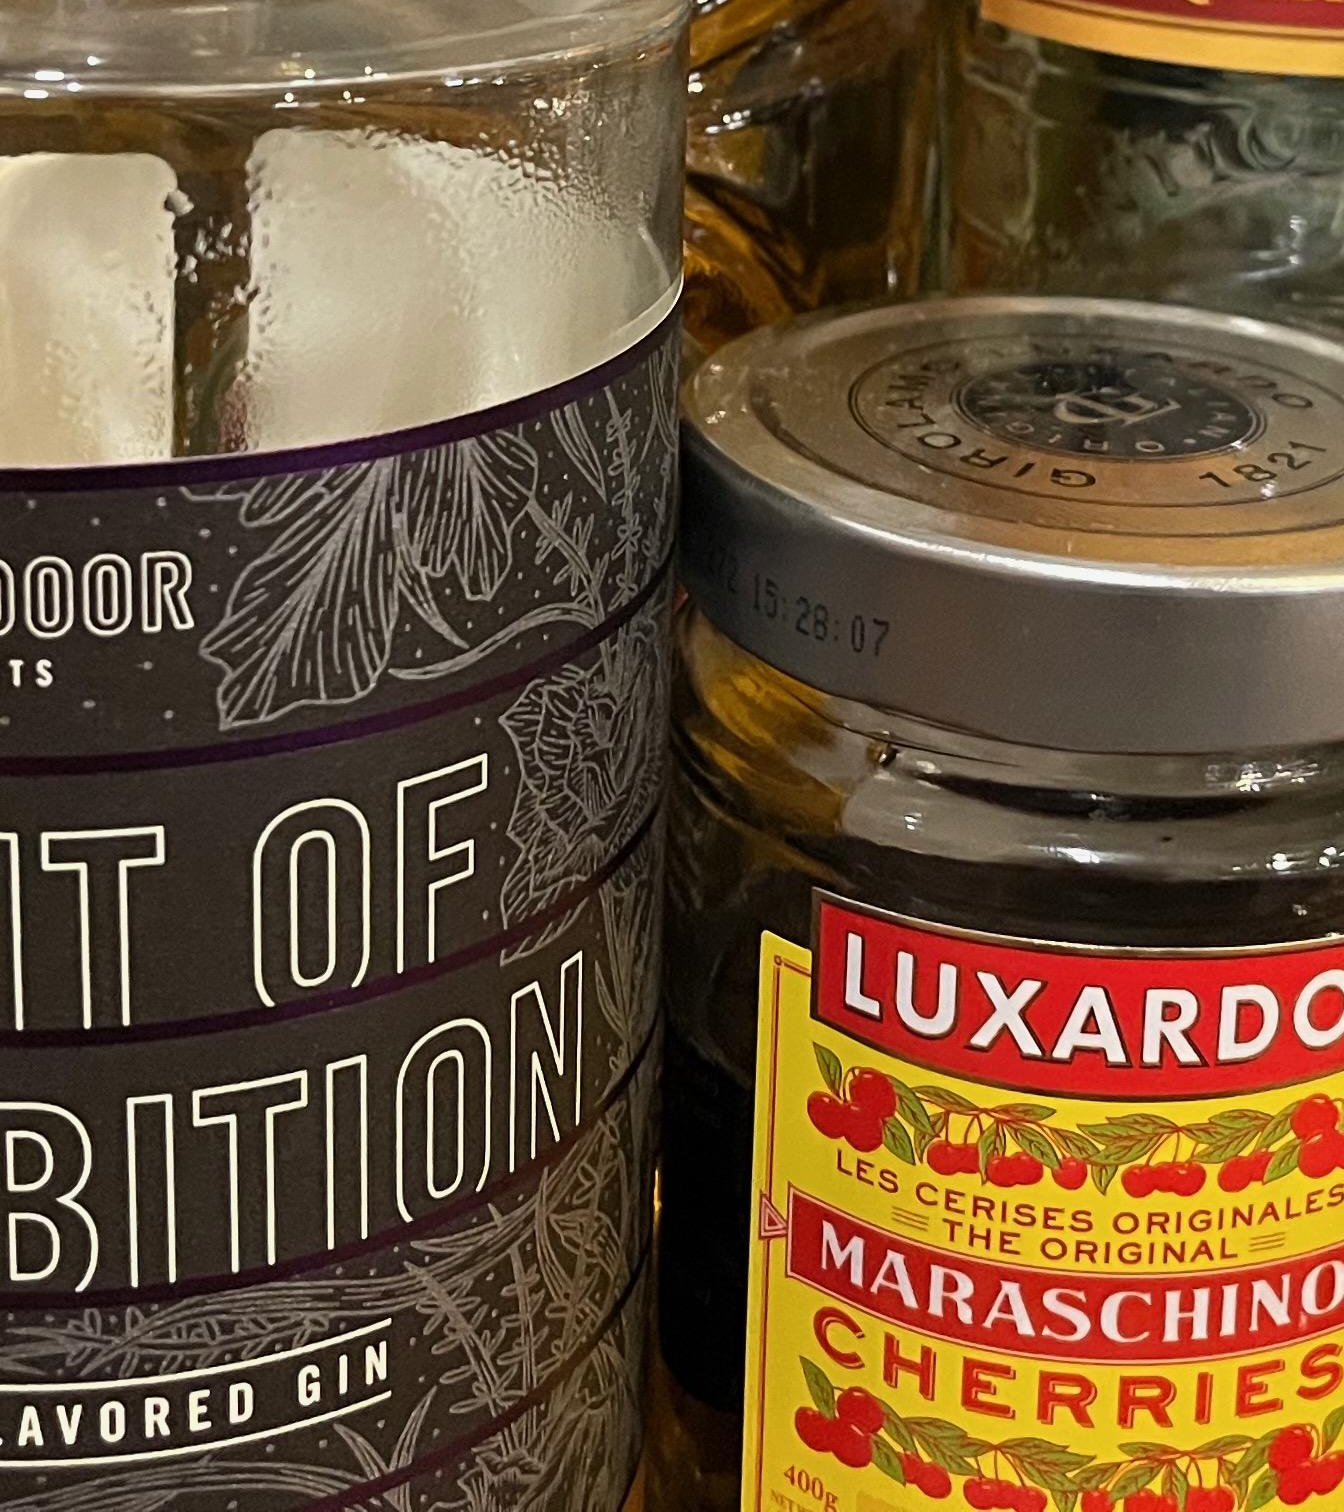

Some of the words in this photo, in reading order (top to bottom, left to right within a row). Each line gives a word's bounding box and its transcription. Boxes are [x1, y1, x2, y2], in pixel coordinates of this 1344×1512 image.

[1198, 439, 1327, 489] 1821
[753, 573, 890, 657] 15:28:07
[253, 752, 490, 1010] OF
[836, 1149, 900, 1195] LES
[914, 1181, 1093, 1234] CERISES
[941, 1221, 1021, 1257] THE
[1039, 1235, 1239, 1266] ORIGINAL
[295, 1338, 389, 1409] GIN
[812, 1305, 1344, 1429] CHERRIES
[783, 1463, 839, 1512] 400g
